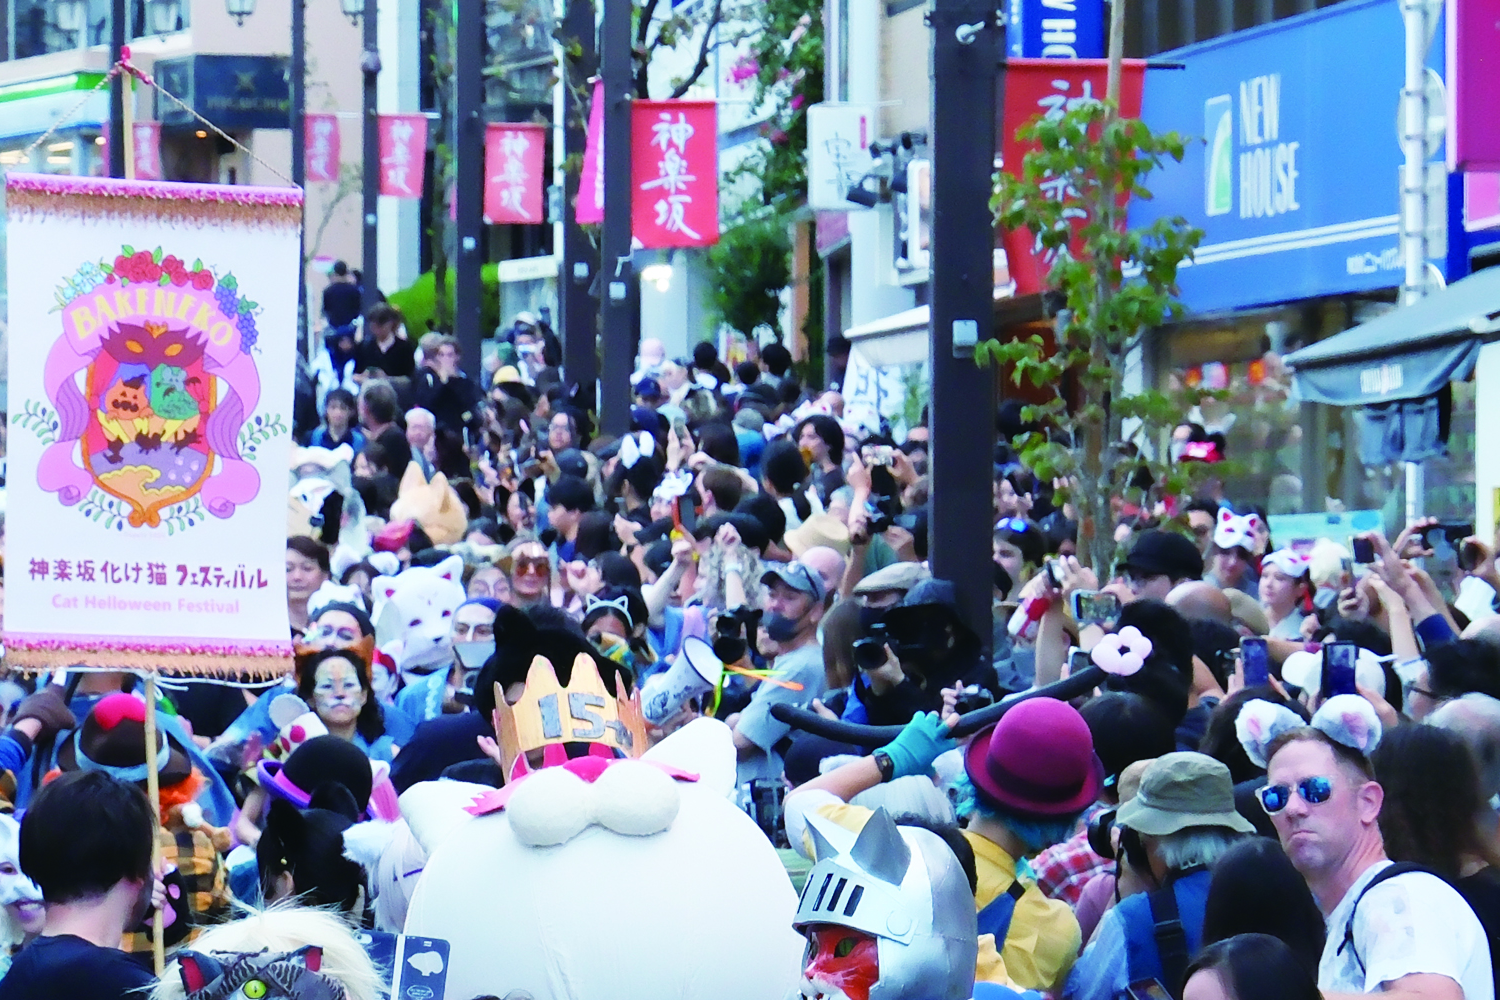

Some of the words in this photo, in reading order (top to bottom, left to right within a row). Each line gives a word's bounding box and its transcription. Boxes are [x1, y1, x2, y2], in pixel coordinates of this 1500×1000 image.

[1239, 72, 1282, 148] NEW
[640, 111, 702, 240] 神楽坂
[1239, 140, 1300, 219] HOUSE
[69, 287, 234, 347] BAKENEKO
[51, 593, 78, 610] Cat
[177, 598, 240, 614] Festival
